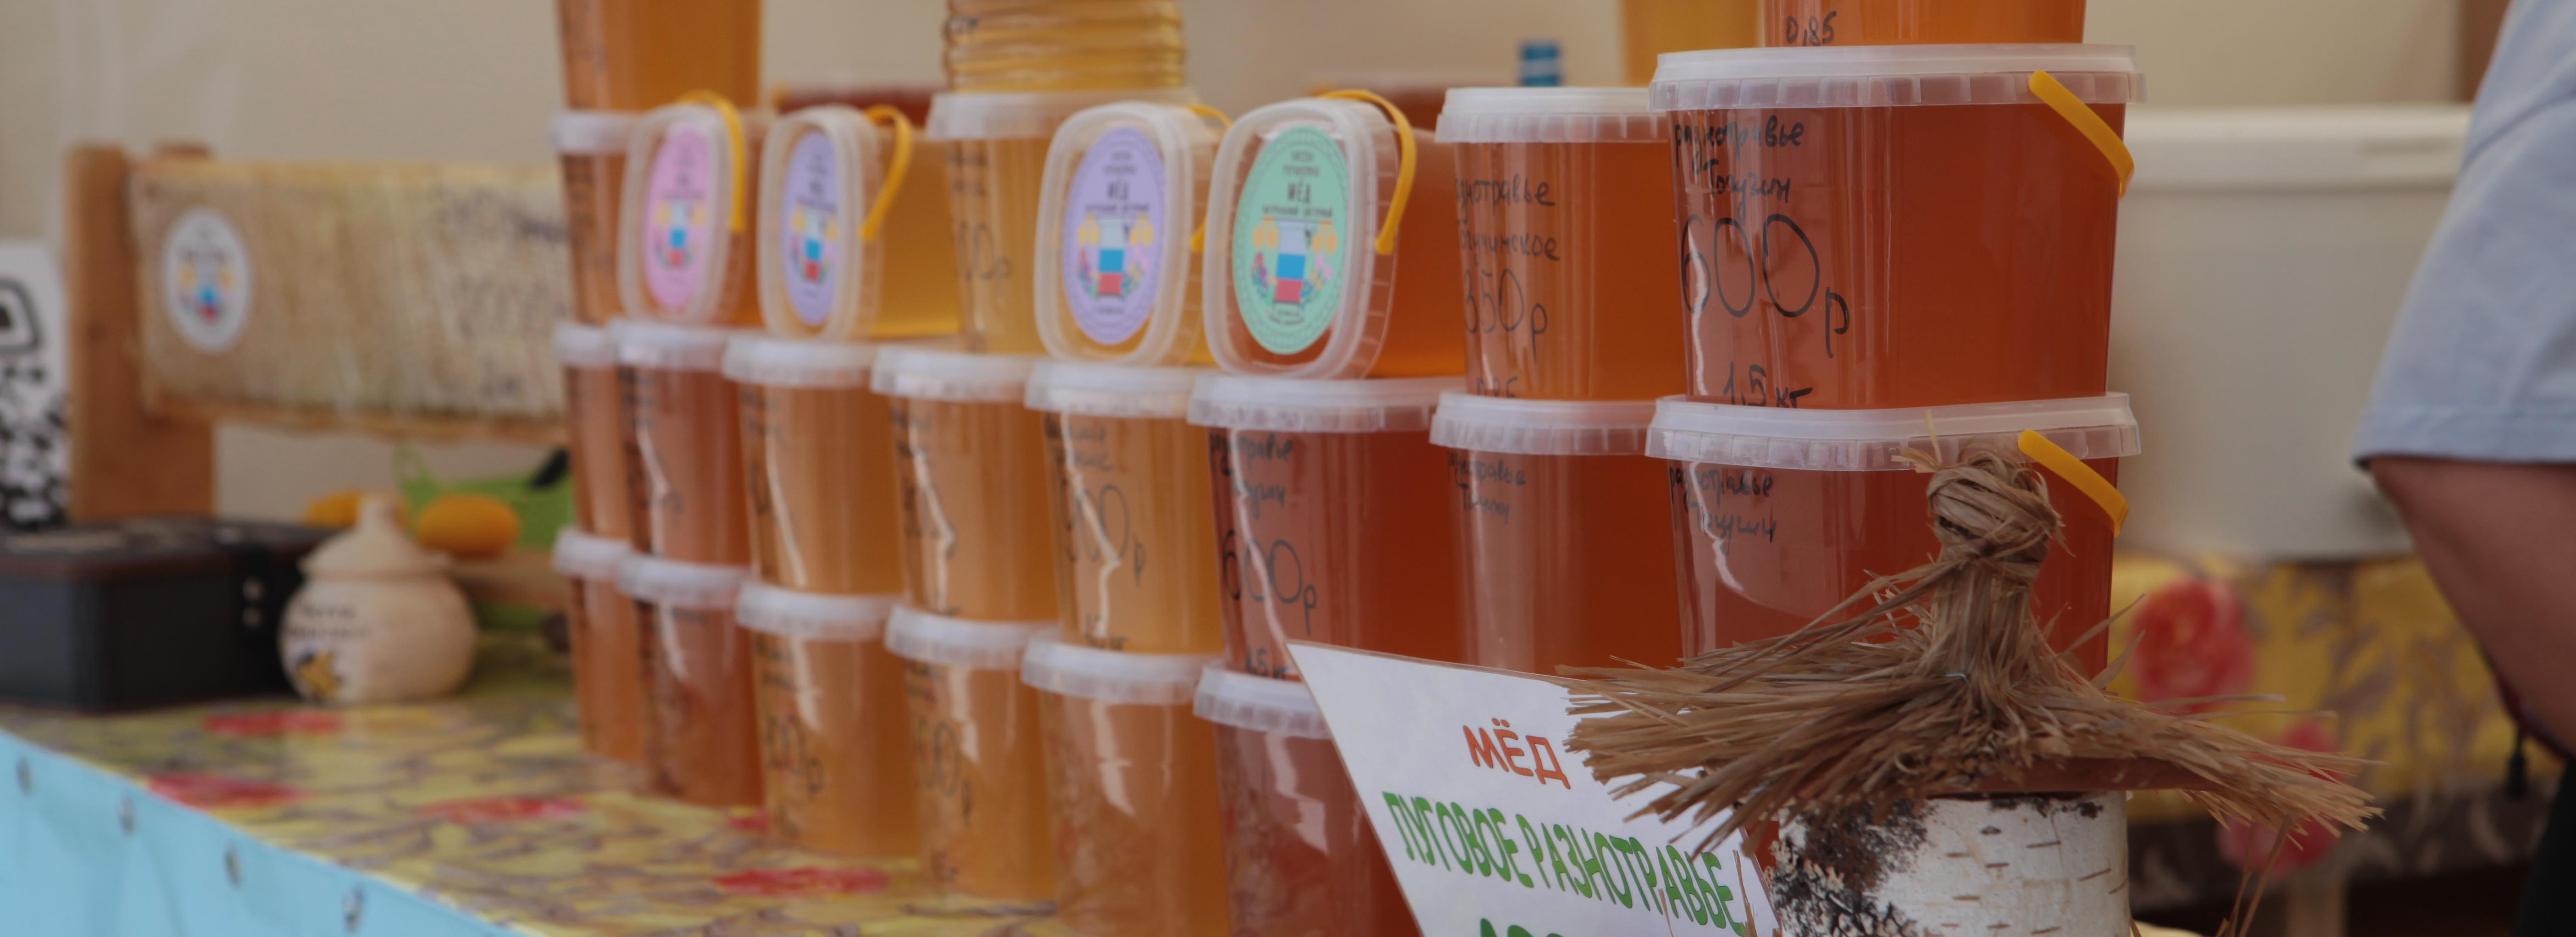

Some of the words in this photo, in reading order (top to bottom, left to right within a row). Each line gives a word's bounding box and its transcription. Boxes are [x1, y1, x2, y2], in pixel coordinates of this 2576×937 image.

[1786, 10, 1837, 47] 0,85
[1462, 717, 1571, 790] МЁД
[1382, 791, 1534, 888] ЛУГОВОЕ
[1515, 813, 1746, 937] РАЗНОТРАВЬЕ
